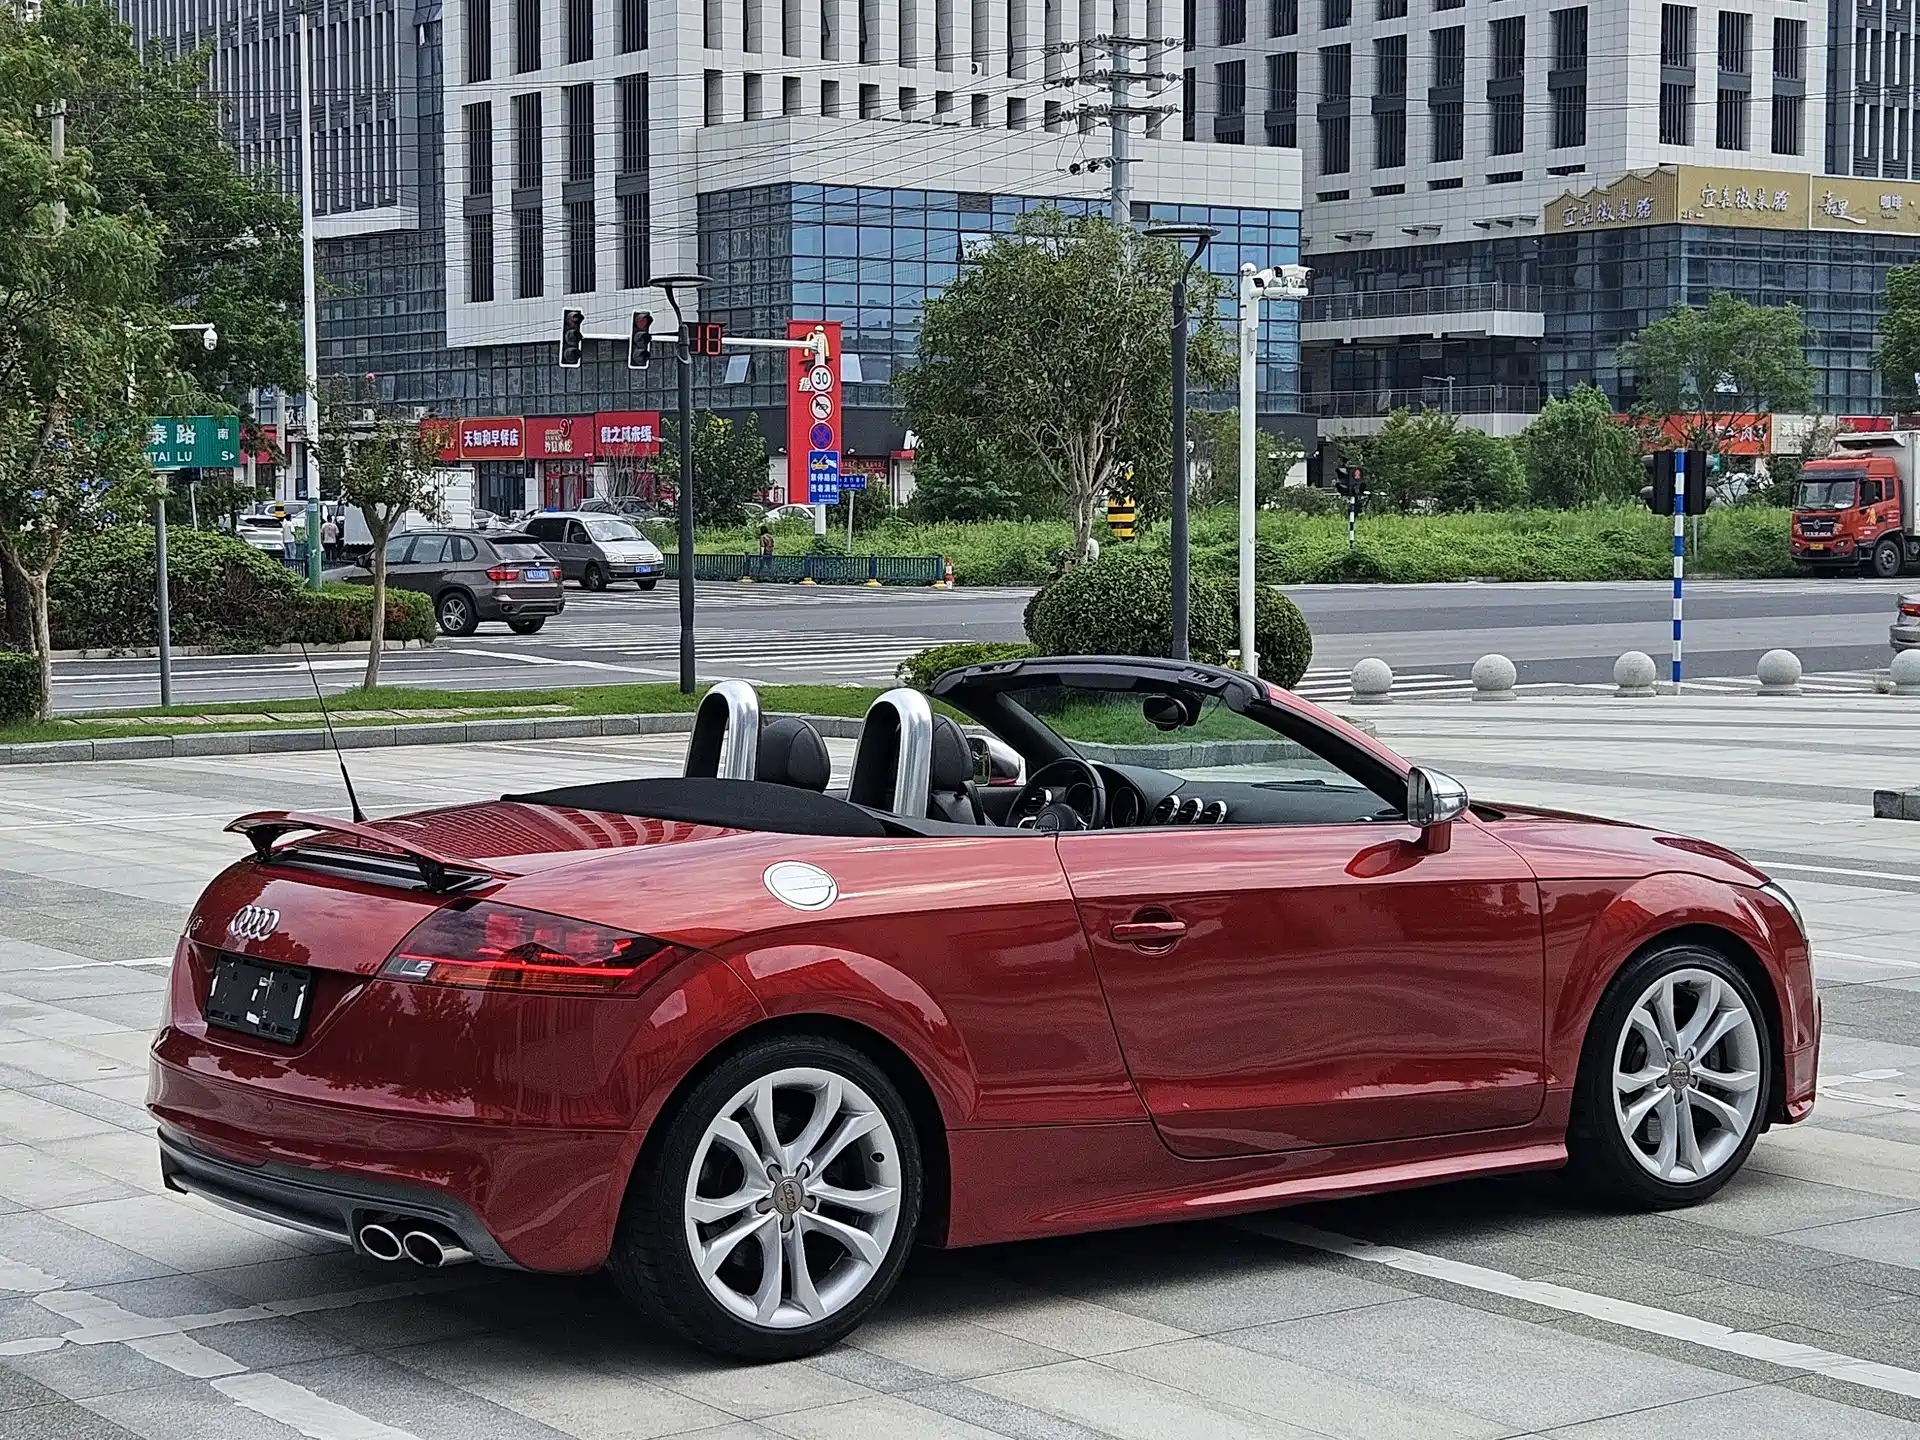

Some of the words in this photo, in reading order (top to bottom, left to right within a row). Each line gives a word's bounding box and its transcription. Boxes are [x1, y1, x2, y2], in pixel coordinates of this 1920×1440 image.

[815, 371, 829, 385] 30
[217, 428, 229, 440] 南
[177, 451, 192, 462] LU
[221, 450, 229, 461] S
